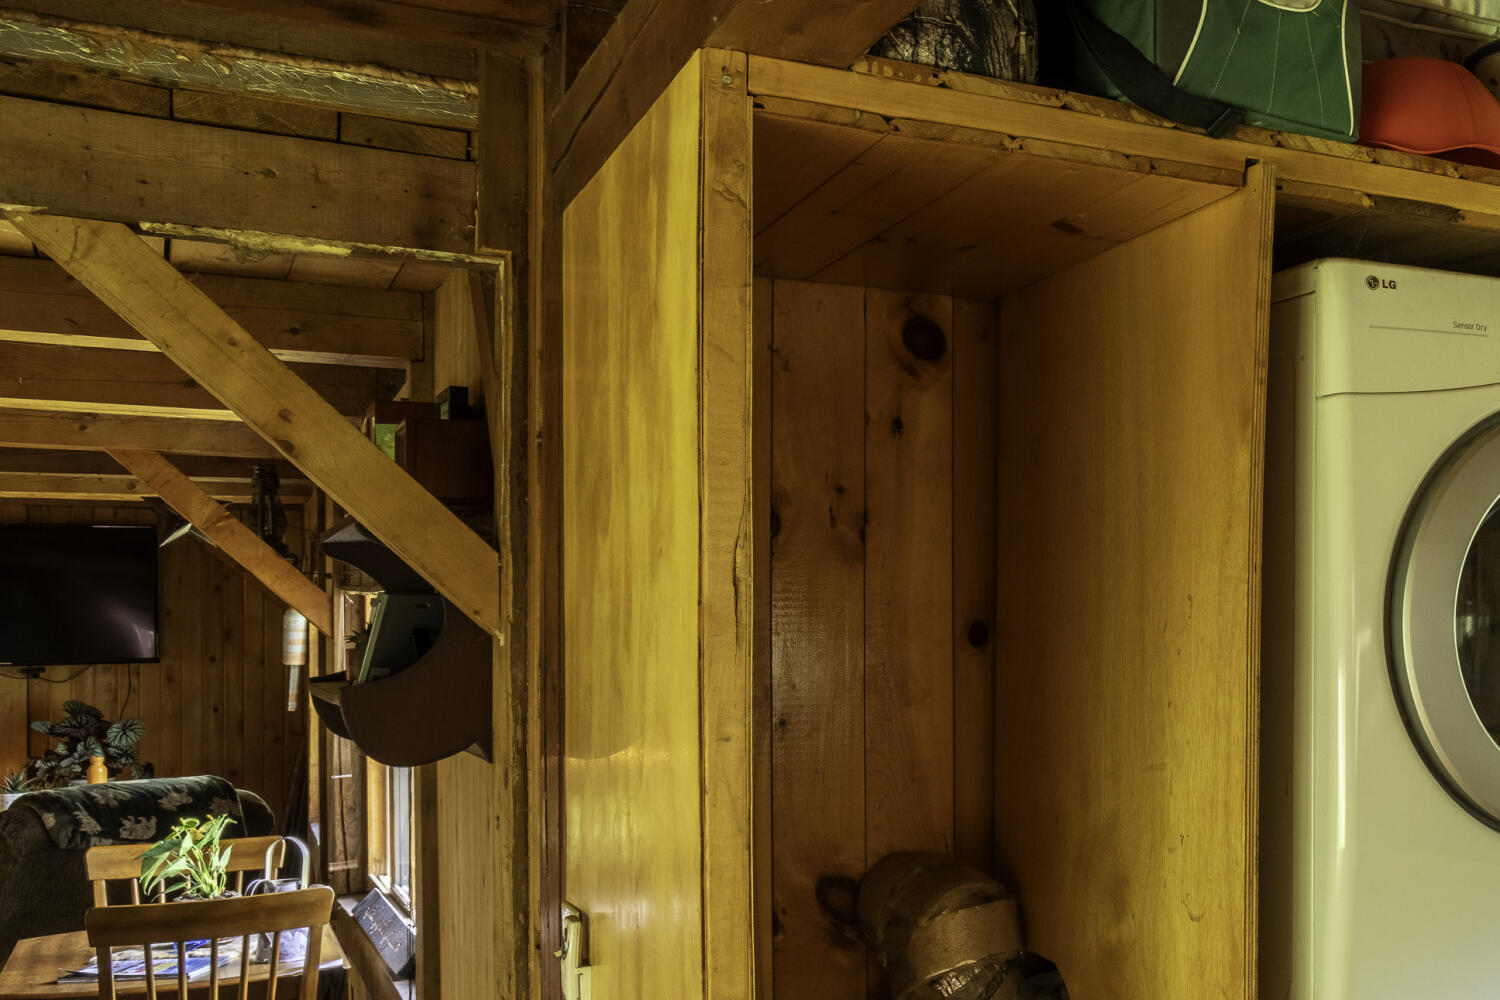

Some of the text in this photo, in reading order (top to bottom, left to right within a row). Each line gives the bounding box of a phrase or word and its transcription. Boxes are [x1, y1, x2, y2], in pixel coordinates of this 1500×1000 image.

[1382, 279, 1397, 290] LG
[1452, 320, 1489, 332] Sensor Dry
